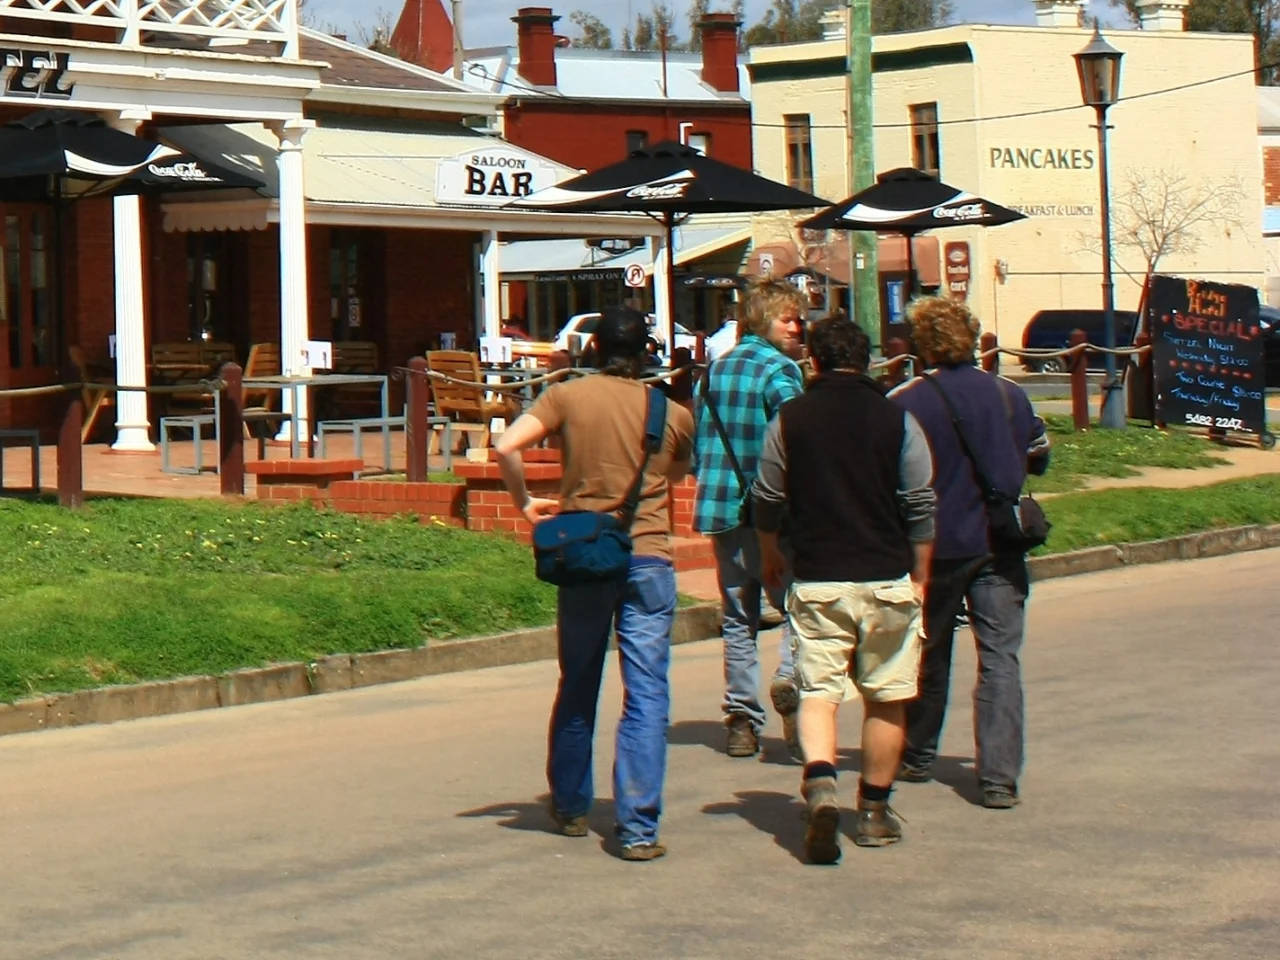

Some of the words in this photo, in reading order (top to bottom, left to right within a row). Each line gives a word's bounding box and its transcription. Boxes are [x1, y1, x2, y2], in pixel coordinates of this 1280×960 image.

[471, 155, 527, 169] SALOON
[989, 147, 1094, 169] PANCAKES
[464, 164, 533, 197] BAR
[1065, 205, 1094, 216] LUNCH
